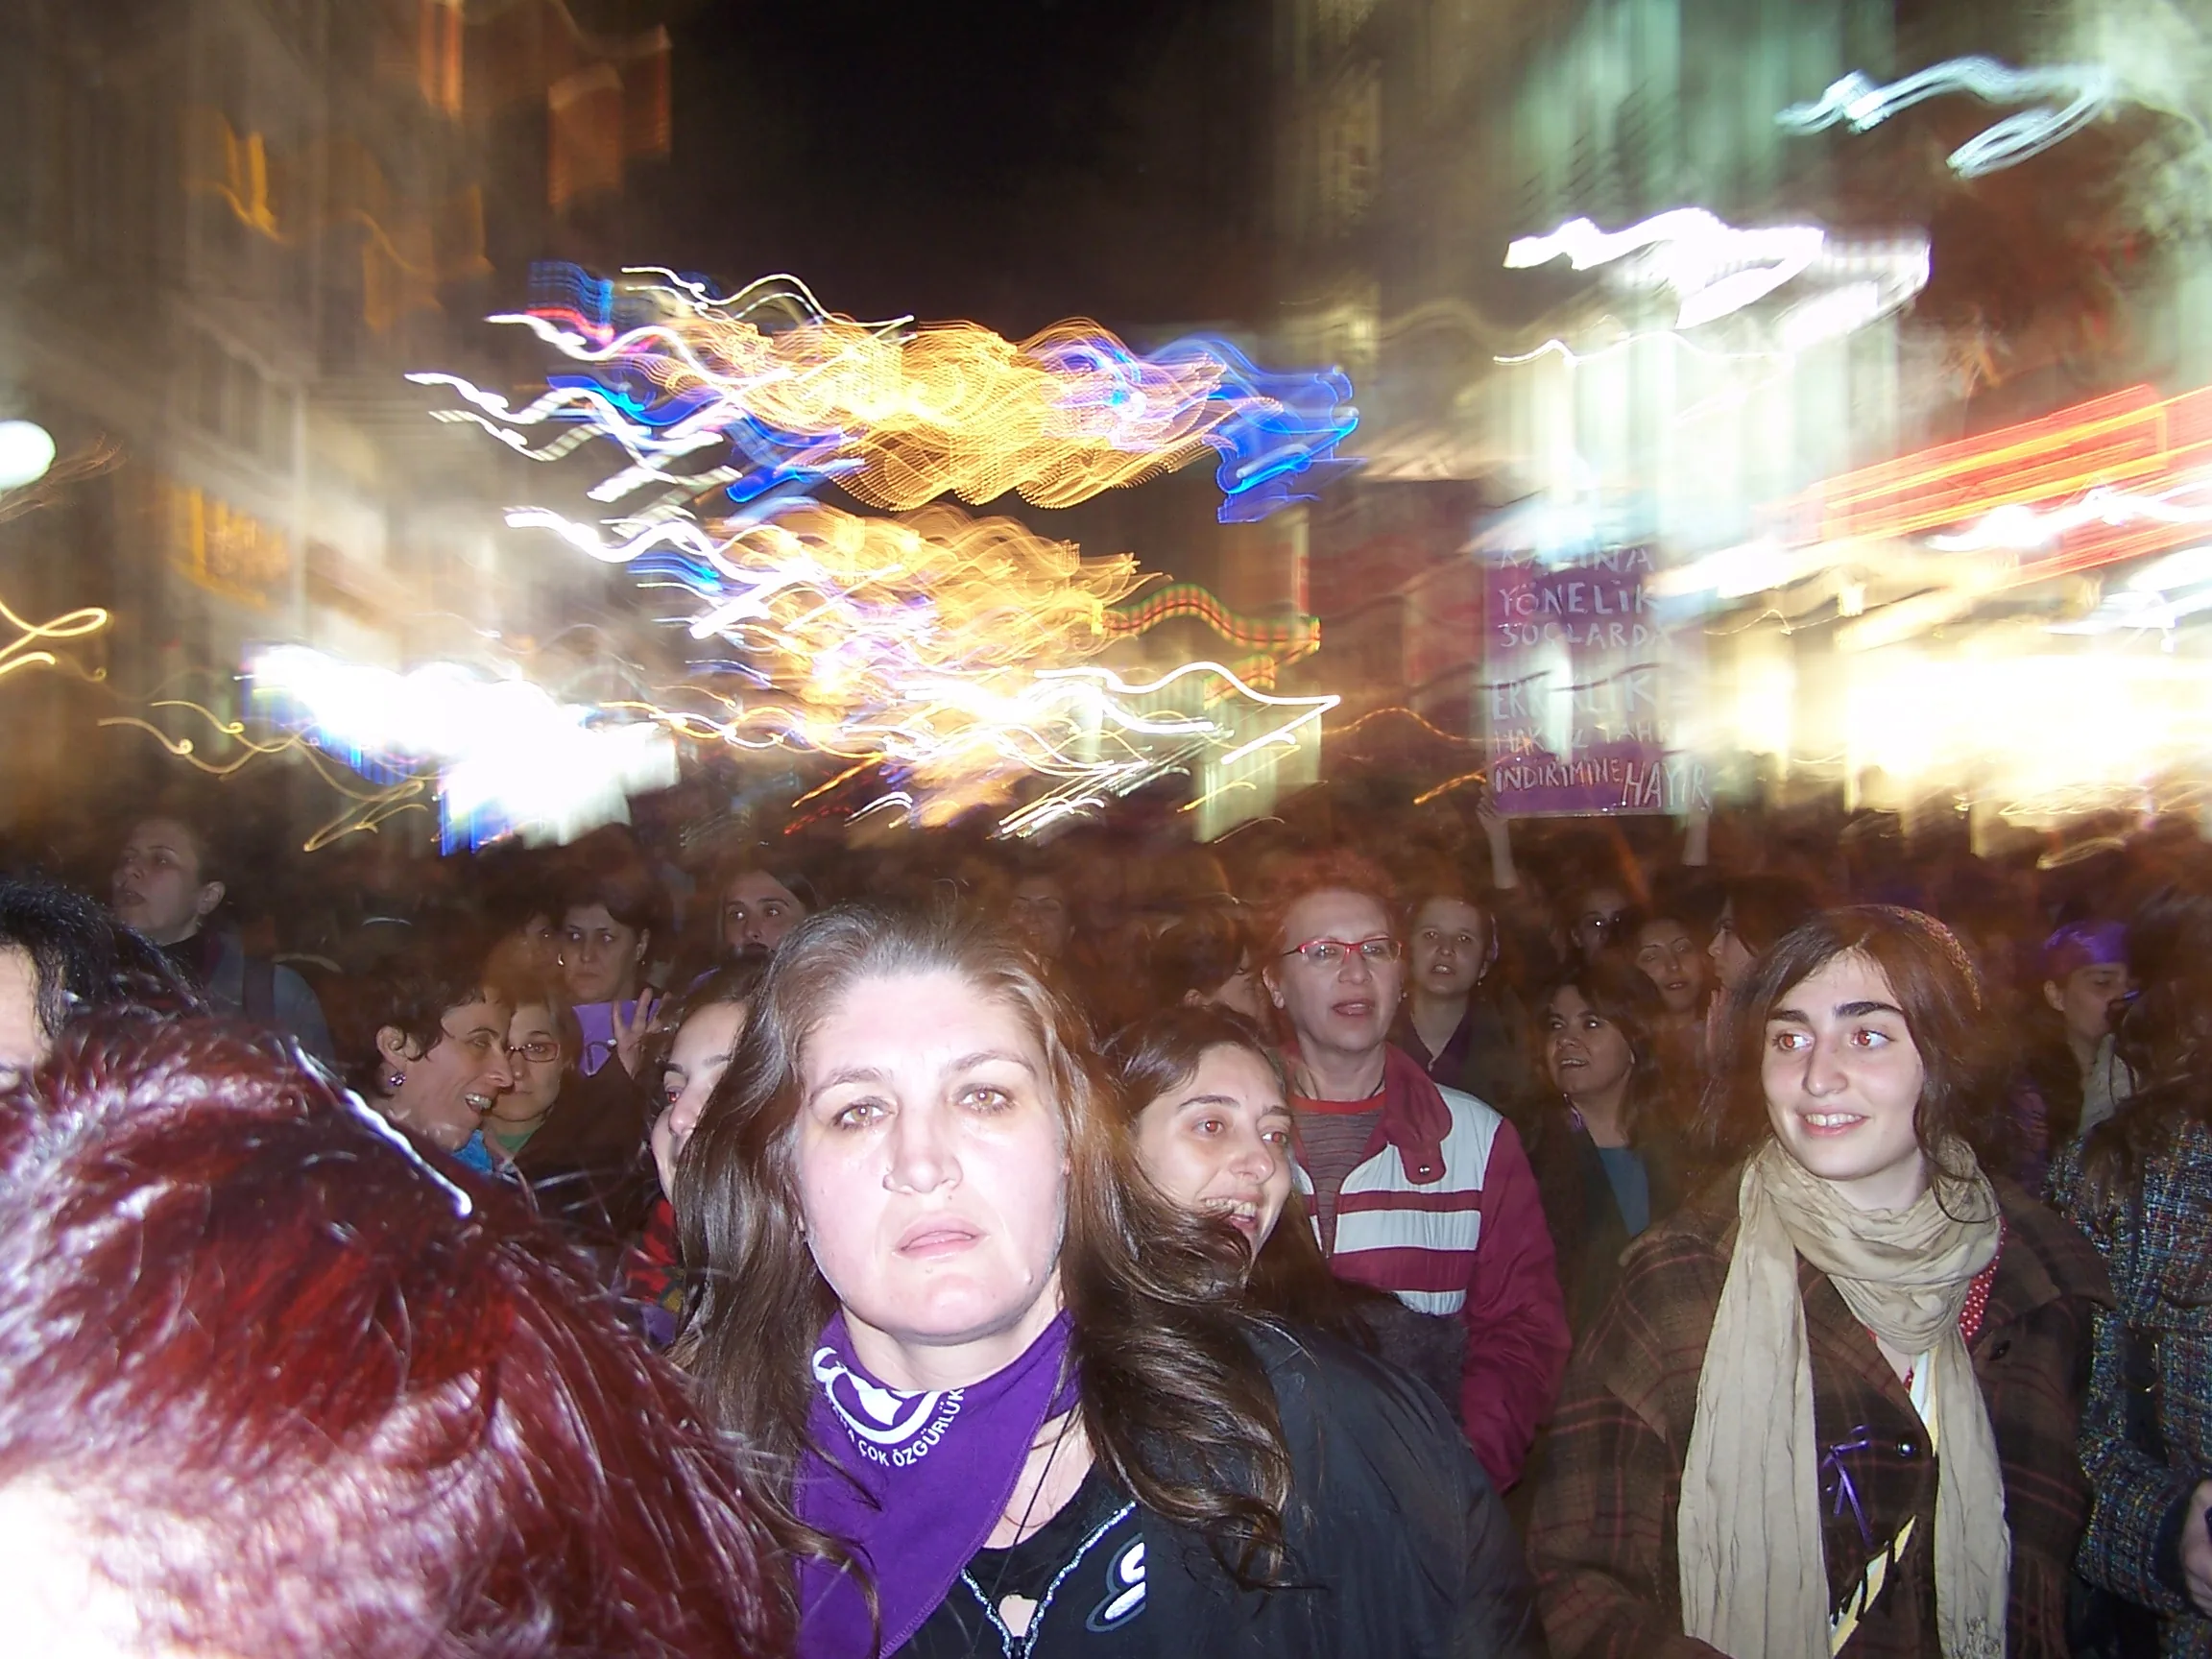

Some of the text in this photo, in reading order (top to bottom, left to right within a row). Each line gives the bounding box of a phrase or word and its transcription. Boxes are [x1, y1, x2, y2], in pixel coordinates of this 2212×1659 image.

[1499, 579, 1661, 617] YÖNELİK
[857, 1439, 890, 1467] ÇOK
[892, 1388, 965, 1467] ÖZGÜRLÜK
